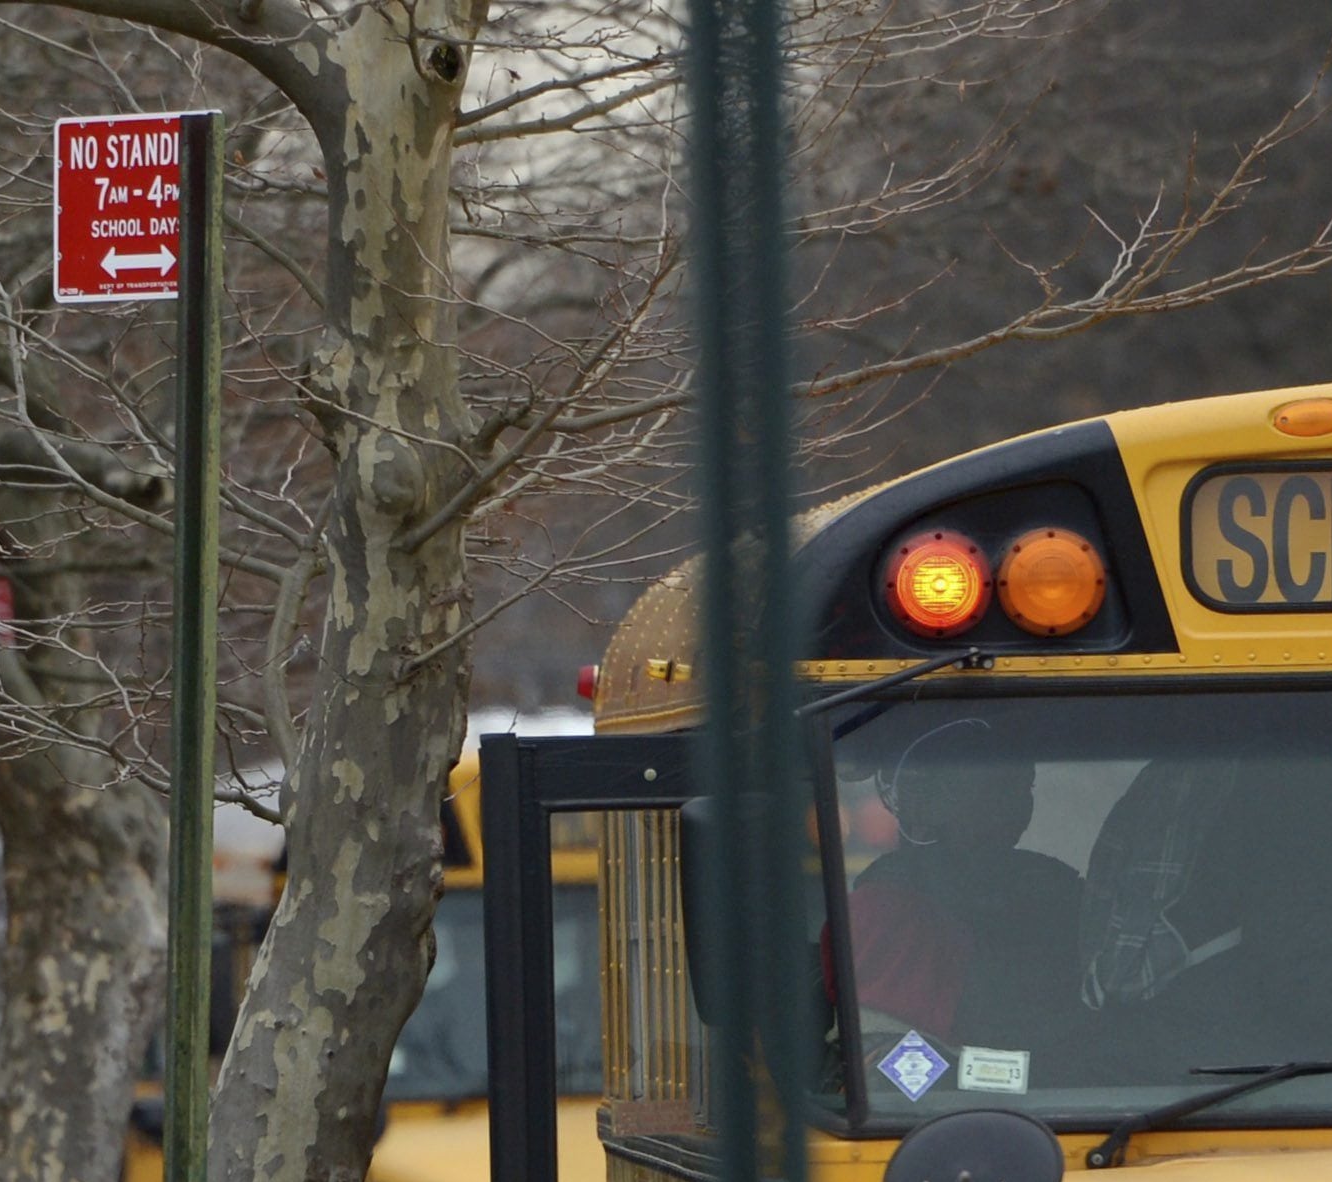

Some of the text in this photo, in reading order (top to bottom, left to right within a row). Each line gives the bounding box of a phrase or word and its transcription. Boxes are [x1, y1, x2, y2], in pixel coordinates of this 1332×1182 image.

[70, 132, 179, 170] NO STANDI
[91, 218, 145, 238] SCHOOL
